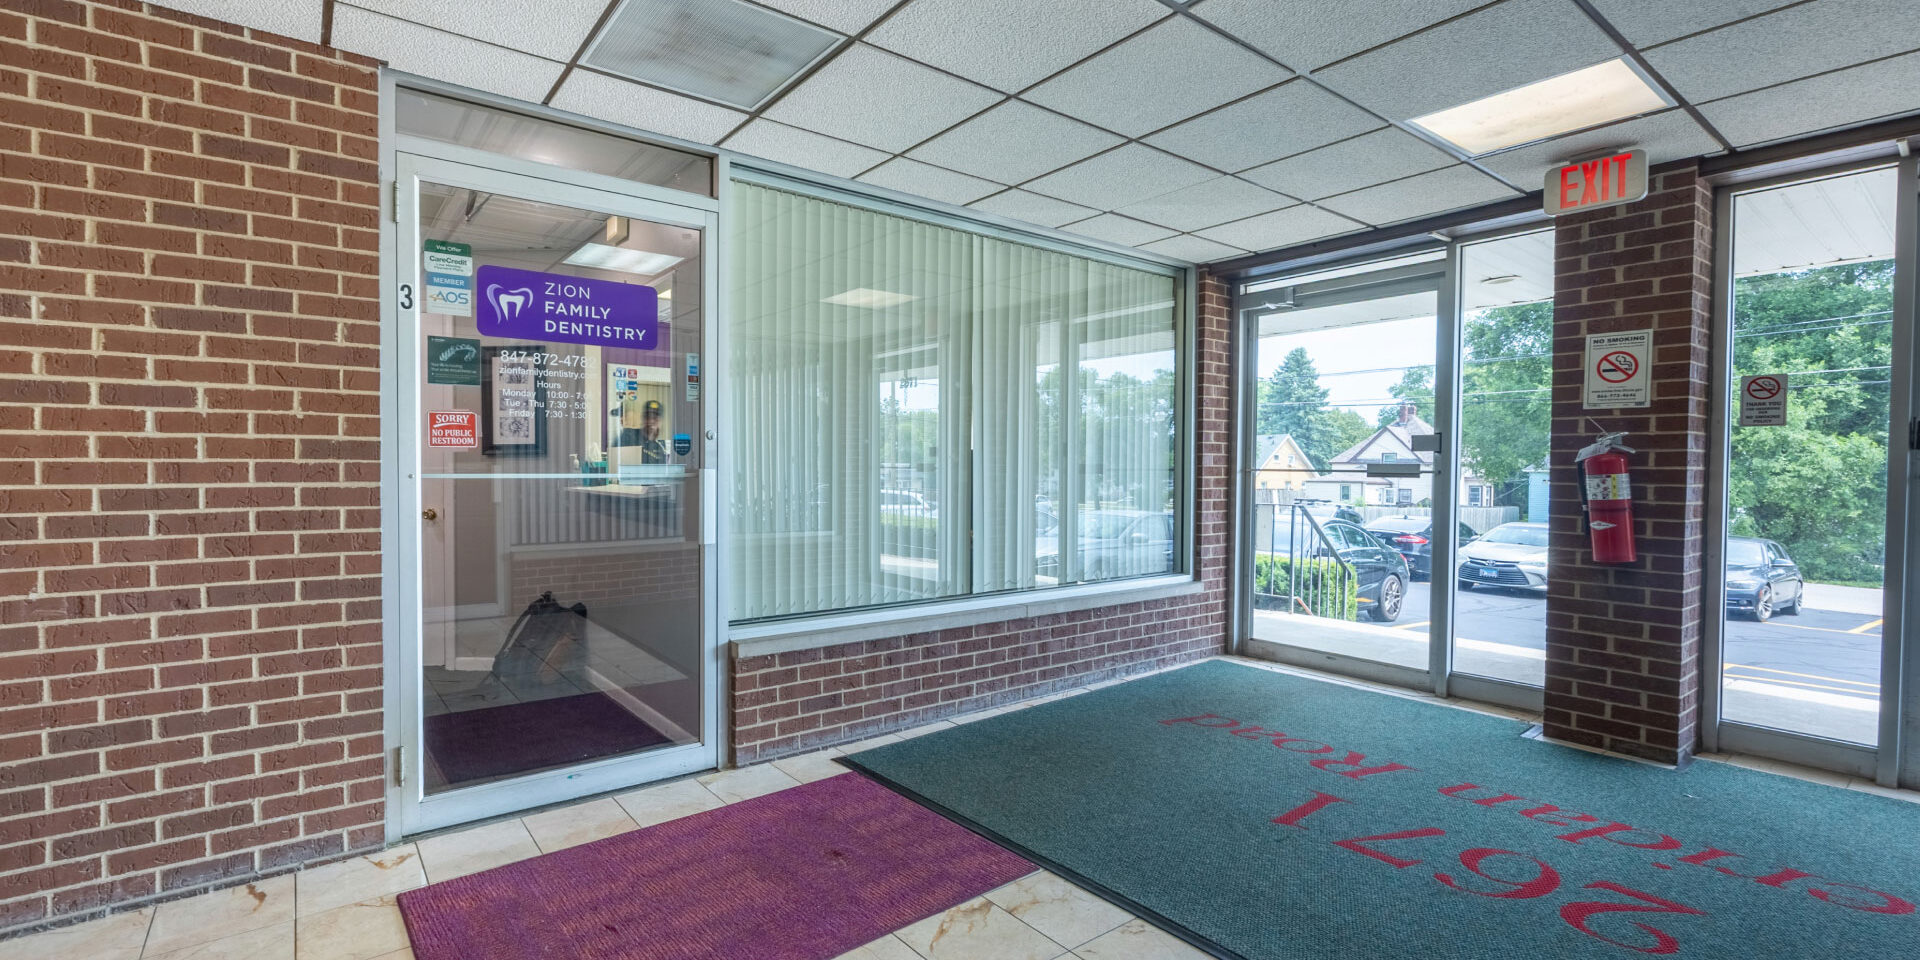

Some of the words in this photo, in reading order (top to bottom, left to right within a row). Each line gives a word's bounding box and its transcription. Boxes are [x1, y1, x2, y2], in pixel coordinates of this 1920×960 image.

[1560, 152, 1632, 209] EXIT
[429, 255, 467, 266] CareCredit
[433, 276, 465, 286] MEMBER
[400, 284, 413, 309] 3
[435, 290, 468, 304] AOS
[545, 282, 590, 299] ZION
[545, 301, 611, 320] FAMILY
[545, 320, 647, 341] DENTISTRY
[1607, 335, 1646, 343] SMOKING
[500, 350, 597, 368] 847-872-4782
[499, 365, 598, 380] zionfamilydentistry.c
[536, 380, 561, 389] Hours
[502, 388, 536, 398] Monday
[546, 391, 569, 399] 10:00
[576, 392, 593, 400] 7:0
[504, 399, 520, 407] Tue
[529, 400, 545, 408] Thu
[550, 401, 567, 409] 7:30
[574, 402, 592, 410] 5:0
[435, 413, 469, 424] SORRY
[509, 409, 535, 419] Friday
[545, 410, 563, 419] 7:30
[432, 428, 443, 437] NO
[445, 429, 472, 437] PUBLIC
[432, 436, 474, 445] RESTROOM
[1158, 713, 1424, 781] Road
[1270, 788, 1708, 954] 2671
